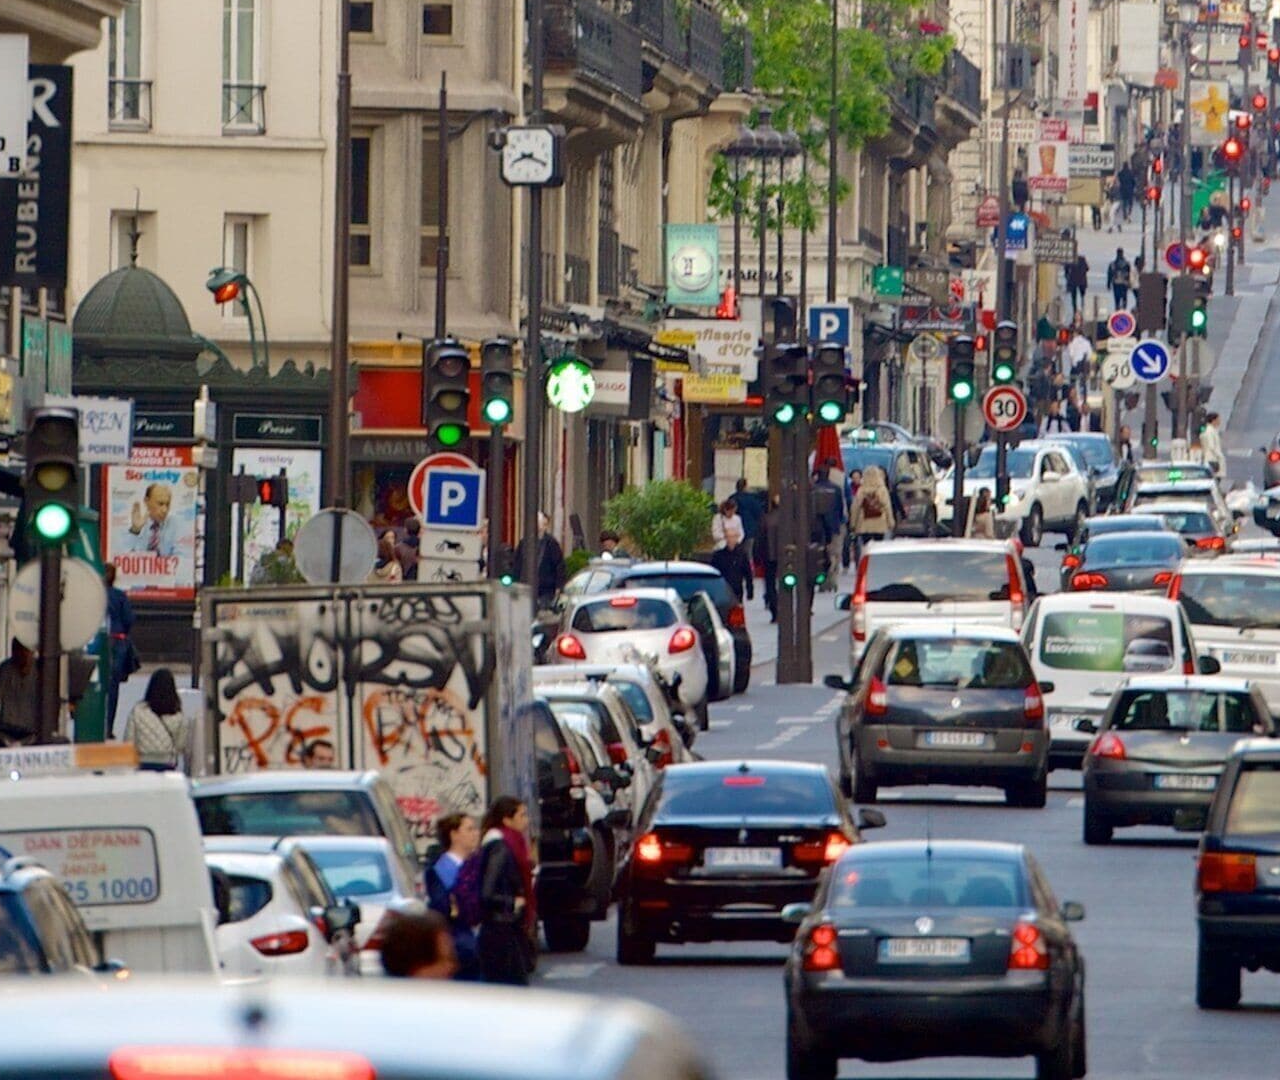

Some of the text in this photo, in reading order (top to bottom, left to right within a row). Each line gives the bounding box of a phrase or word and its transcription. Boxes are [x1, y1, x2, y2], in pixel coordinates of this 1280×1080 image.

[820, 313, 841, 341] P
[994, 399, 1017, 417] 30
[125, 469, 181, 483] Society
[440, 481, 467, 516] P
[114, 554, 180, 576] POUTINE?
[98, 877, 154, 899] 1000
